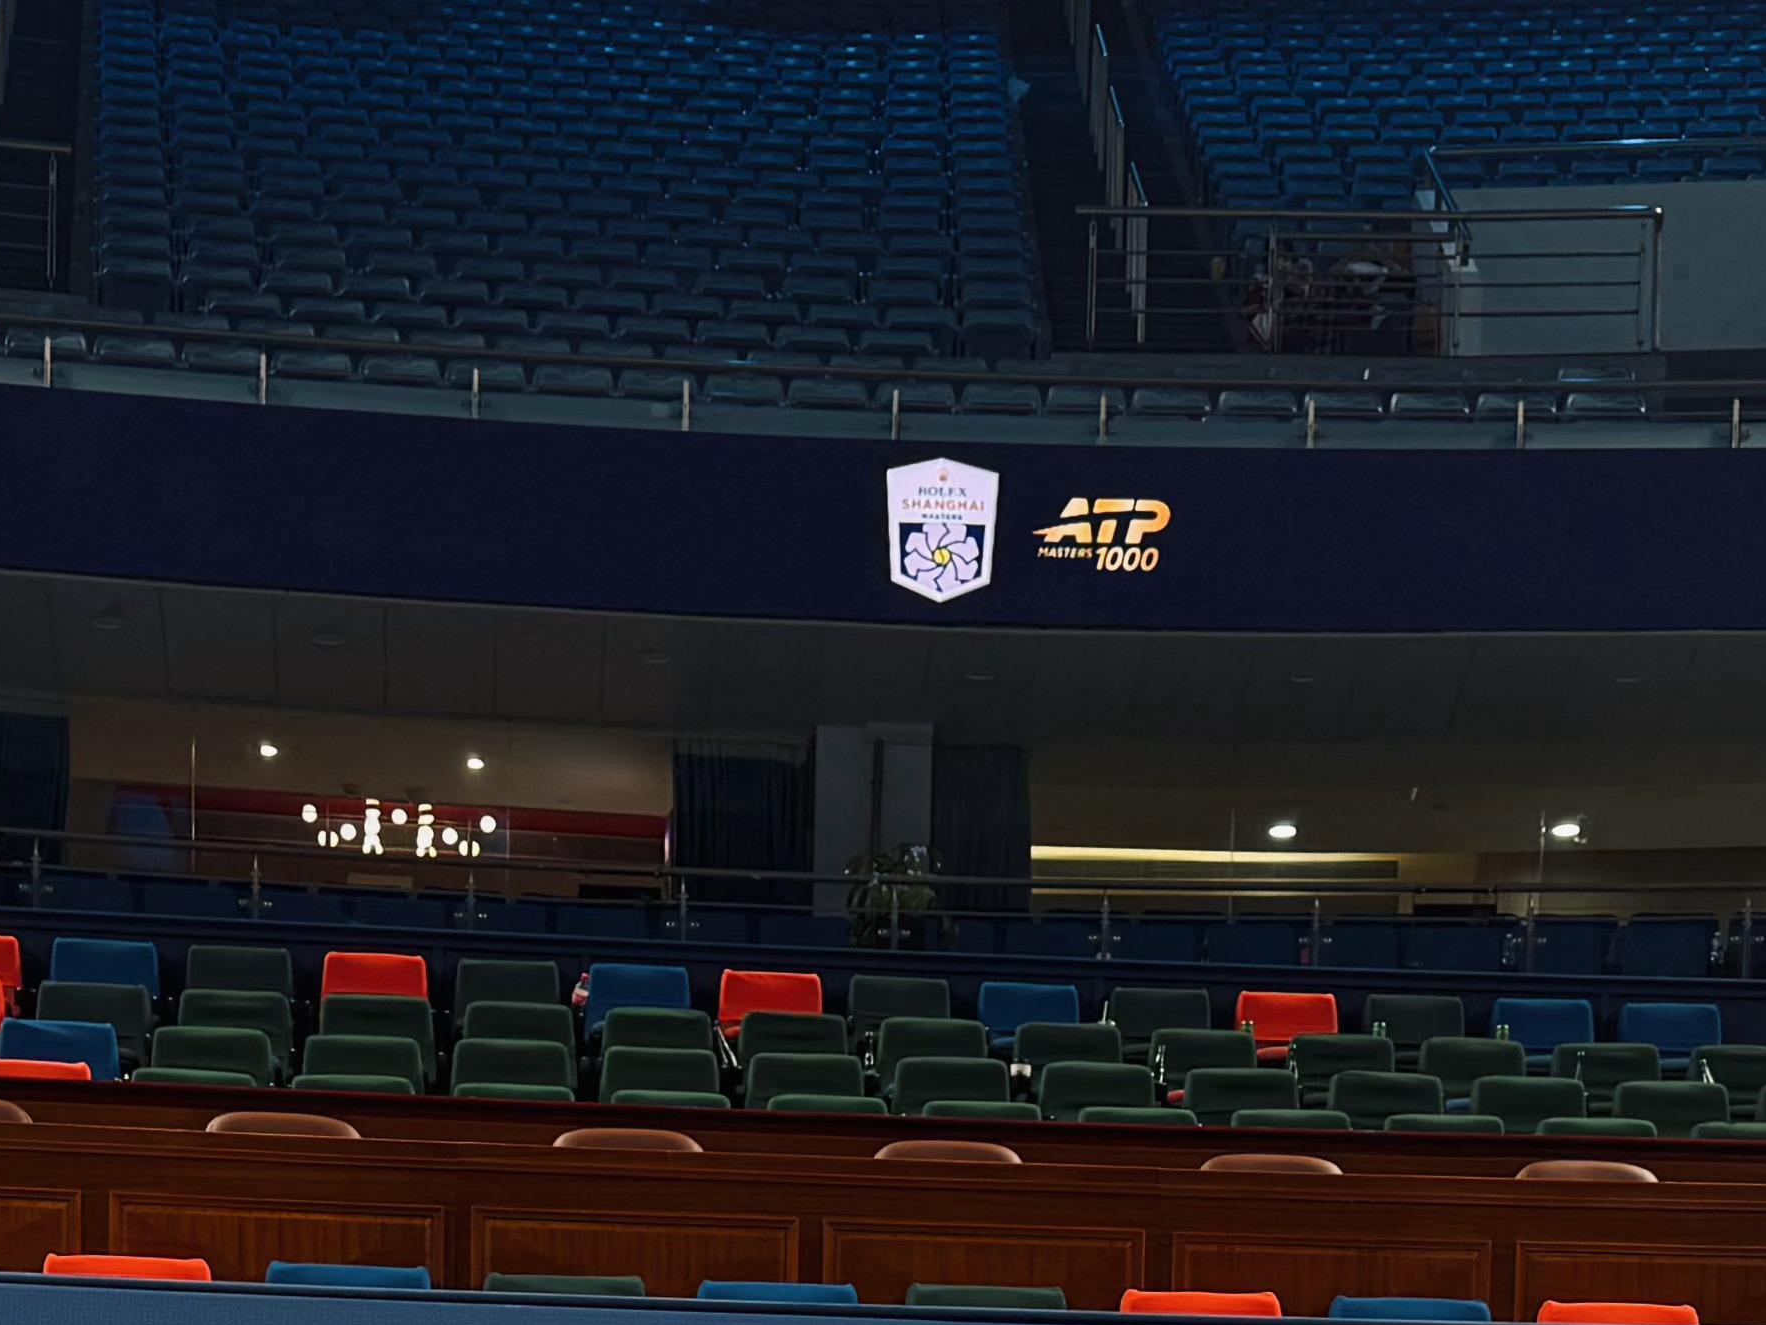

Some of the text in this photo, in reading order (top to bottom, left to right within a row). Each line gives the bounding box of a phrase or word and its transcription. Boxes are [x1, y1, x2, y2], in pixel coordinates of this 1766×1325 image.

[918, 486, 967, 497] ROLEX
[902, 499, 985, 512] SHANGHAI
[1032, 497, 1171, 544] ATP
[1095, 546, 1160, 572] 1000
